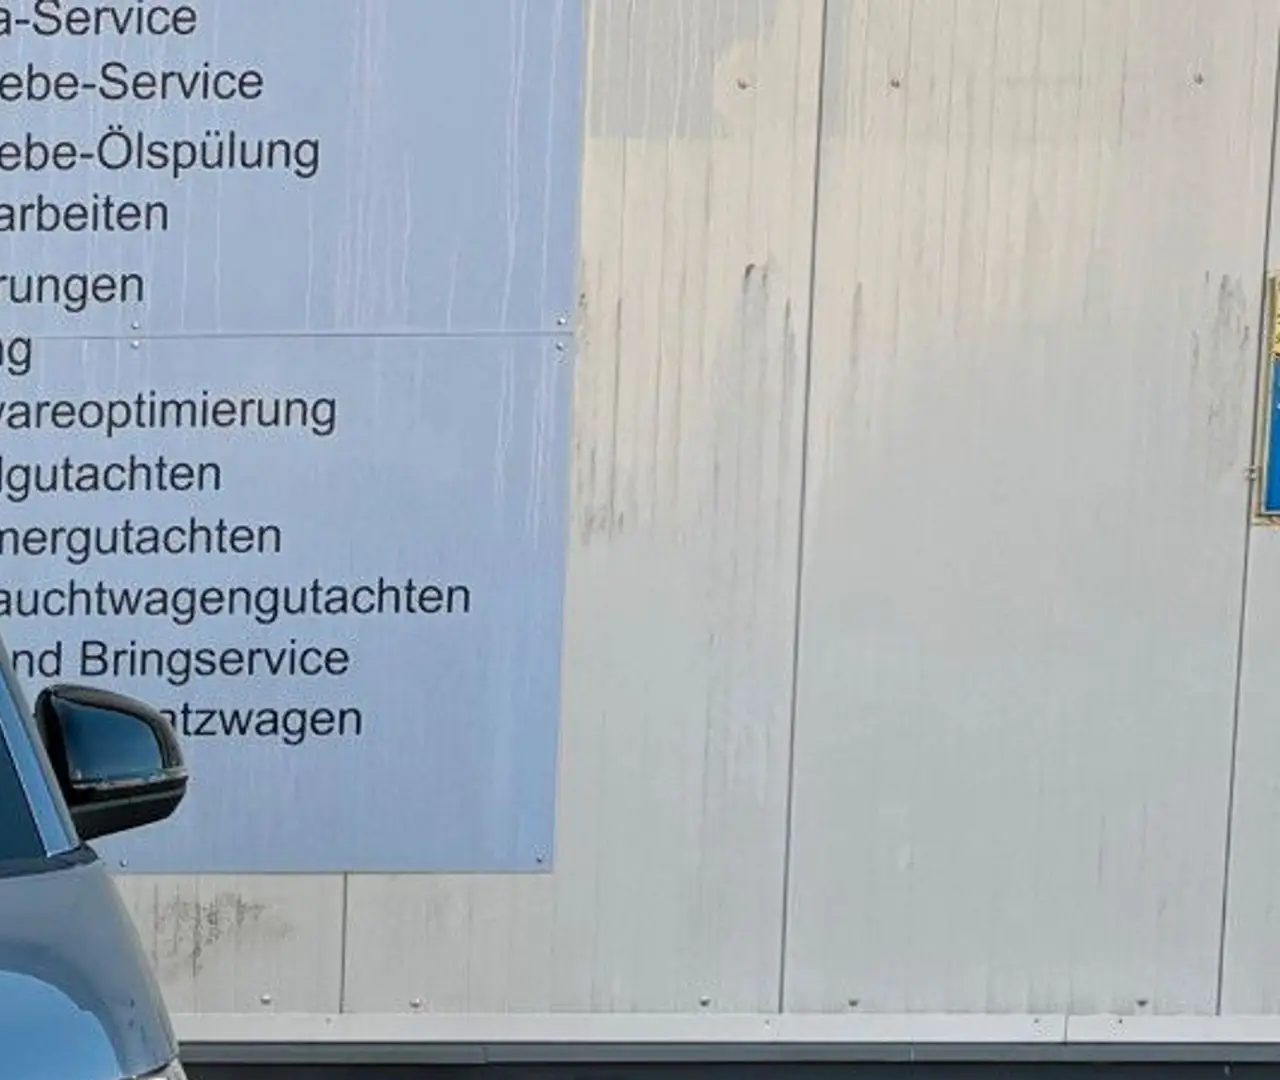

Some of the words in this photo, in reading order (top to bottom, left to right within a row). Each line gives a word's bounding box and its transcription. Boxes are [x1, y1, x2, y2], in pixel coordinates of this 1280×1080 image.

[13, 641, 63, 678] nd
[80, 640, 350, 686] Bringservice
[160, 702, 363, 745] tzwagen
